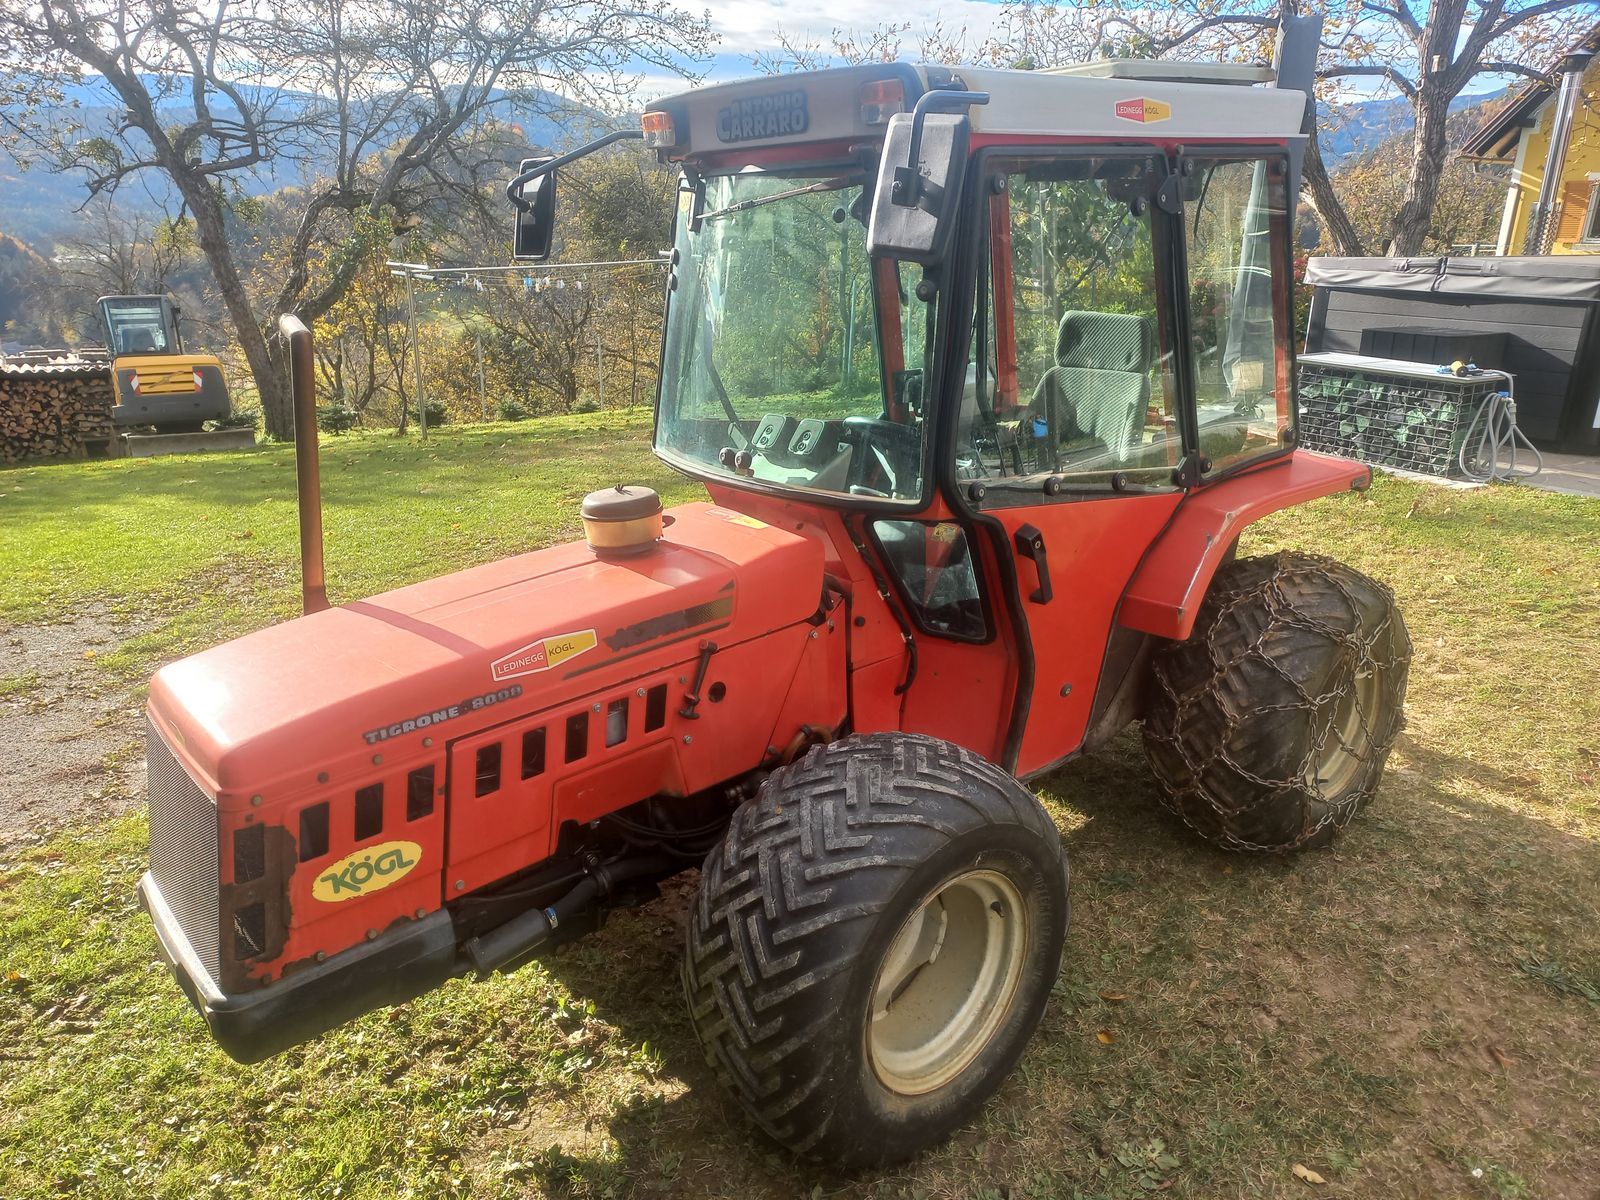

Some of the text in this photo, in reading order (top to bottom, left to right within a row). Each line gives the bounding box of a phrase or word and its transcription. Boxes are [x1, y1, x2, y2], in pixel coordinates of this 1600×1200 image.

[730, 92, 803, 118] ANTONIO
[1117, 106, 1143, 114] LEDINEGG
[718, 109, 805, 140] CARRARO
[497, 642, 576, 674] LEDINEGG KÖGL
[364, 705, 460, 745] TIGRONE
[320, 848, 415, 894] KÖGL
